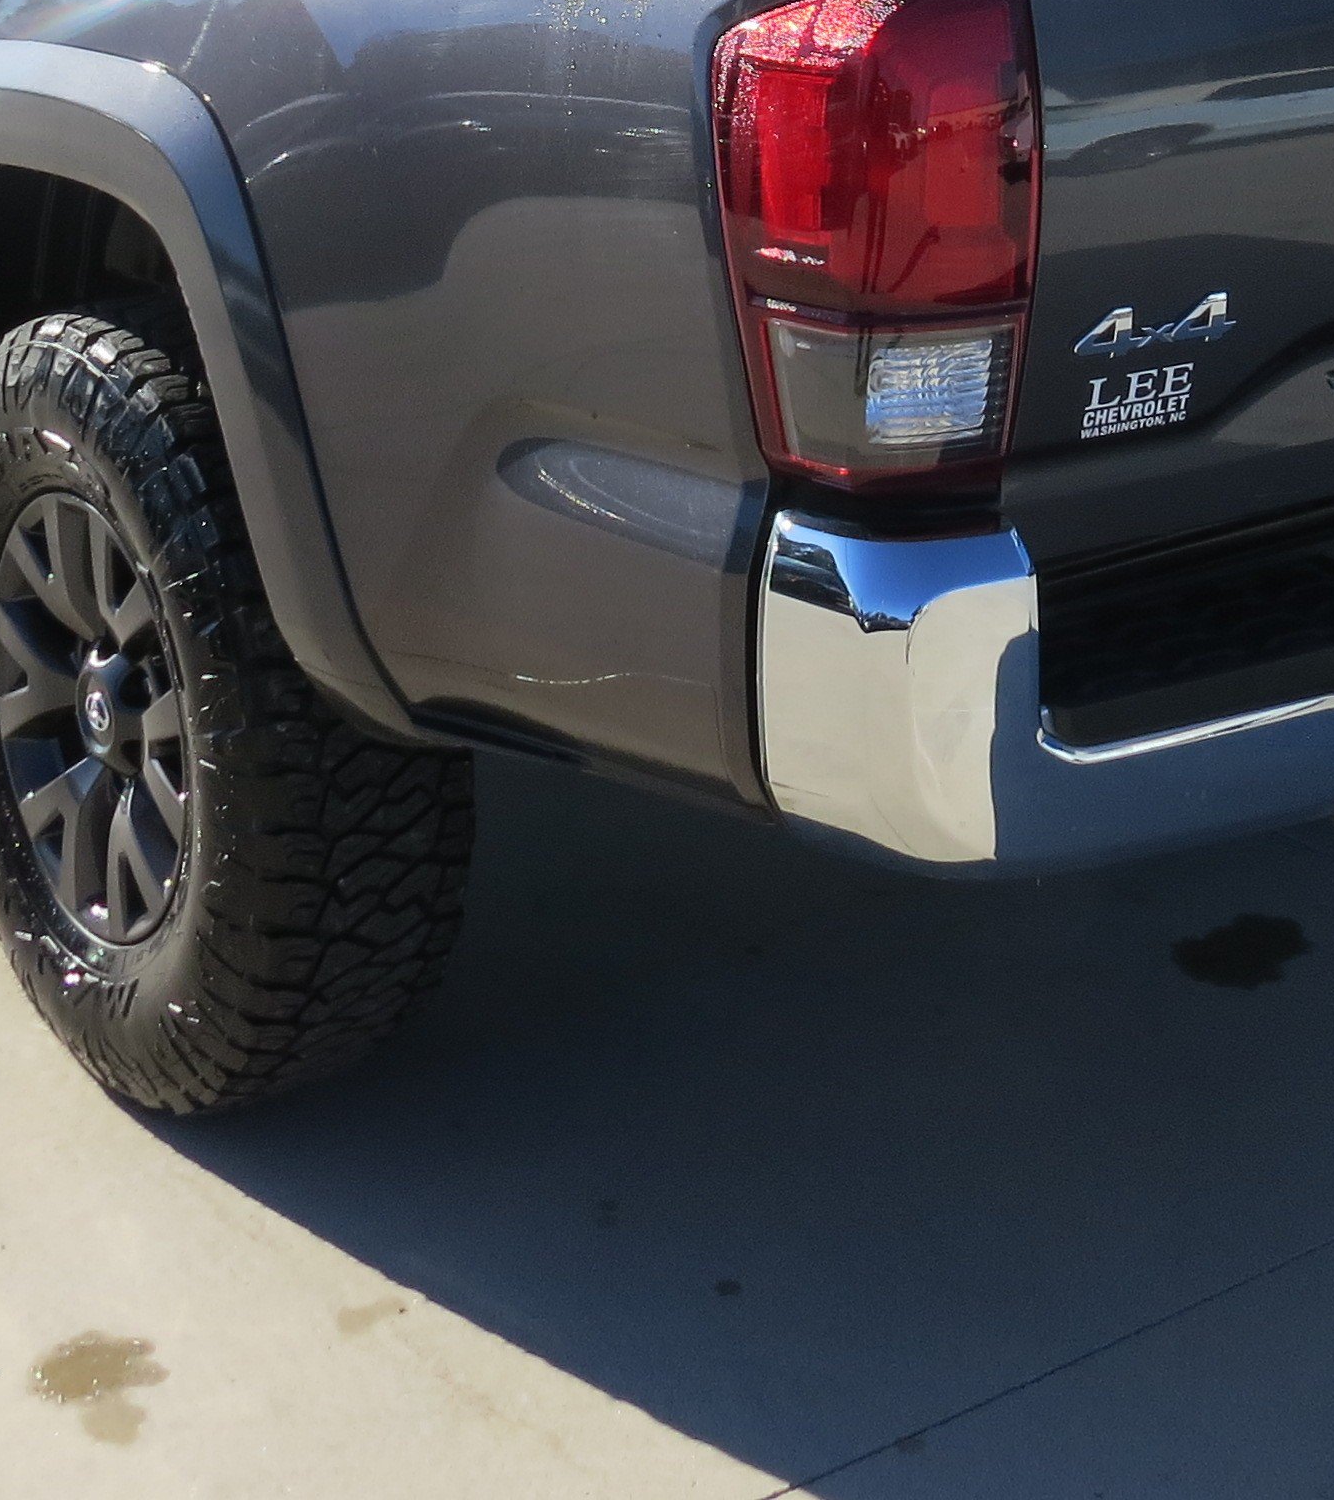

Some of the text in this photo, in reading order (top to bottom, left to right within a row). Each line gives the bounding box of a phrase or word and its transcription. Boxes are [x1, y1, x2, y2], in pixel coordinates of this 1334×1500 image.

[1084, 362, 1194, 411] LEE
[1081, 393, 1190, 428] CHEVROLET
[1168, 411, 1187, 423] NC
